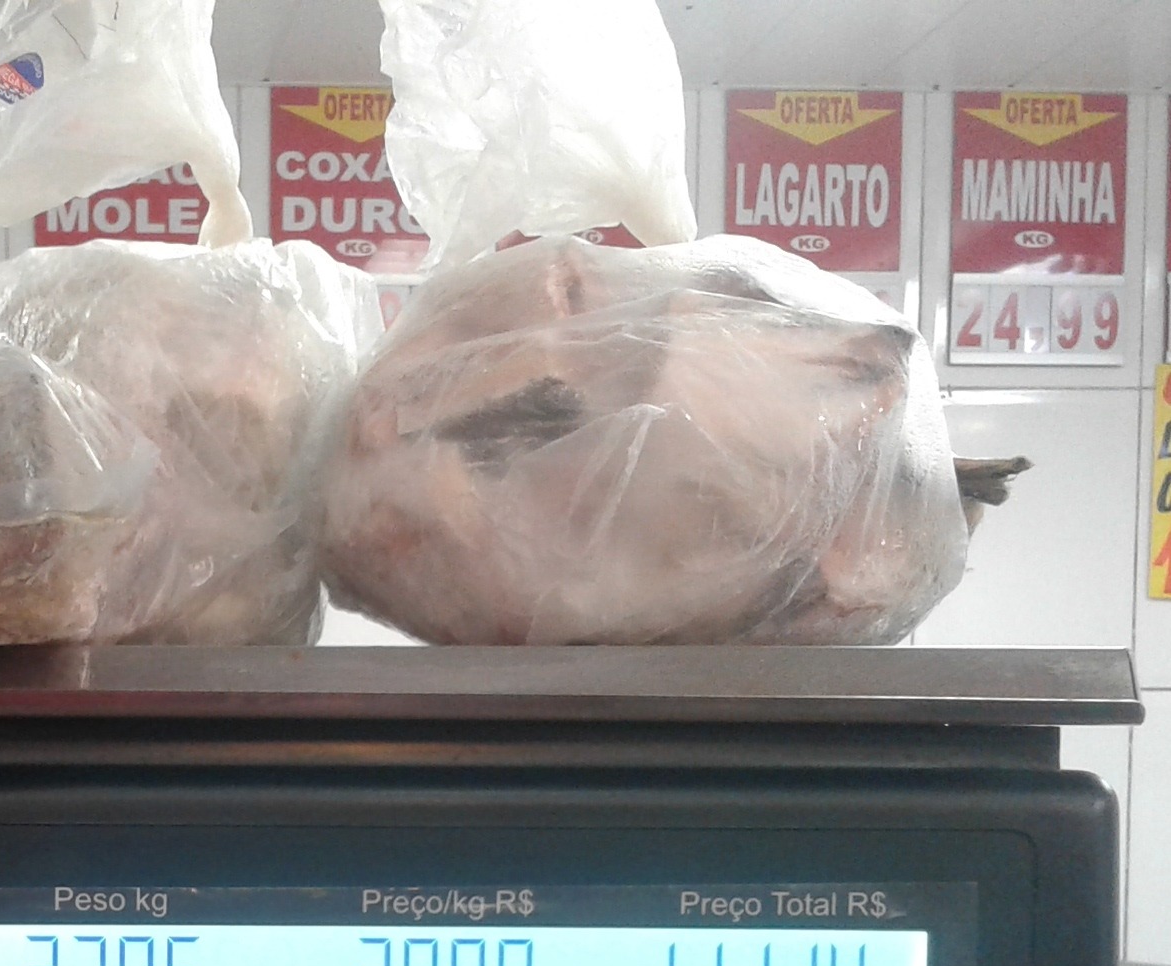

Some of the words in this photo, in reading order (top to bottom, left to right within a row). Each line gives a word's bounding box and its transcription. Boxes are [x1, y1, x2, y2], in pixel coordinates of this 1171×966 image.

[780, 95, 854, 125] OFERTA
[1006, 97, 1077, 126] OFERTA
[735, 163, 889, 228] LAGARTO
[961, 159, 1116, 224] MAMINHA
[46, 198, 200, 234] MOLE
[344, 241, 373, 253] KG
[797, 236, 825, 250] KG
[1023, 232, 1049, 246] KG
[956, 292, 1119, 350] 24,99
[54, 887, 125, 911] Peso
[136, 886, 168, 916] kg
[362, 889, 485, 920] Preço/kg
[496, 889, 534, 917] R$
[680, 892, 762, 922] Preço
[771, 891, 837, 916] Total
[848, 892, 887, 919] R$
